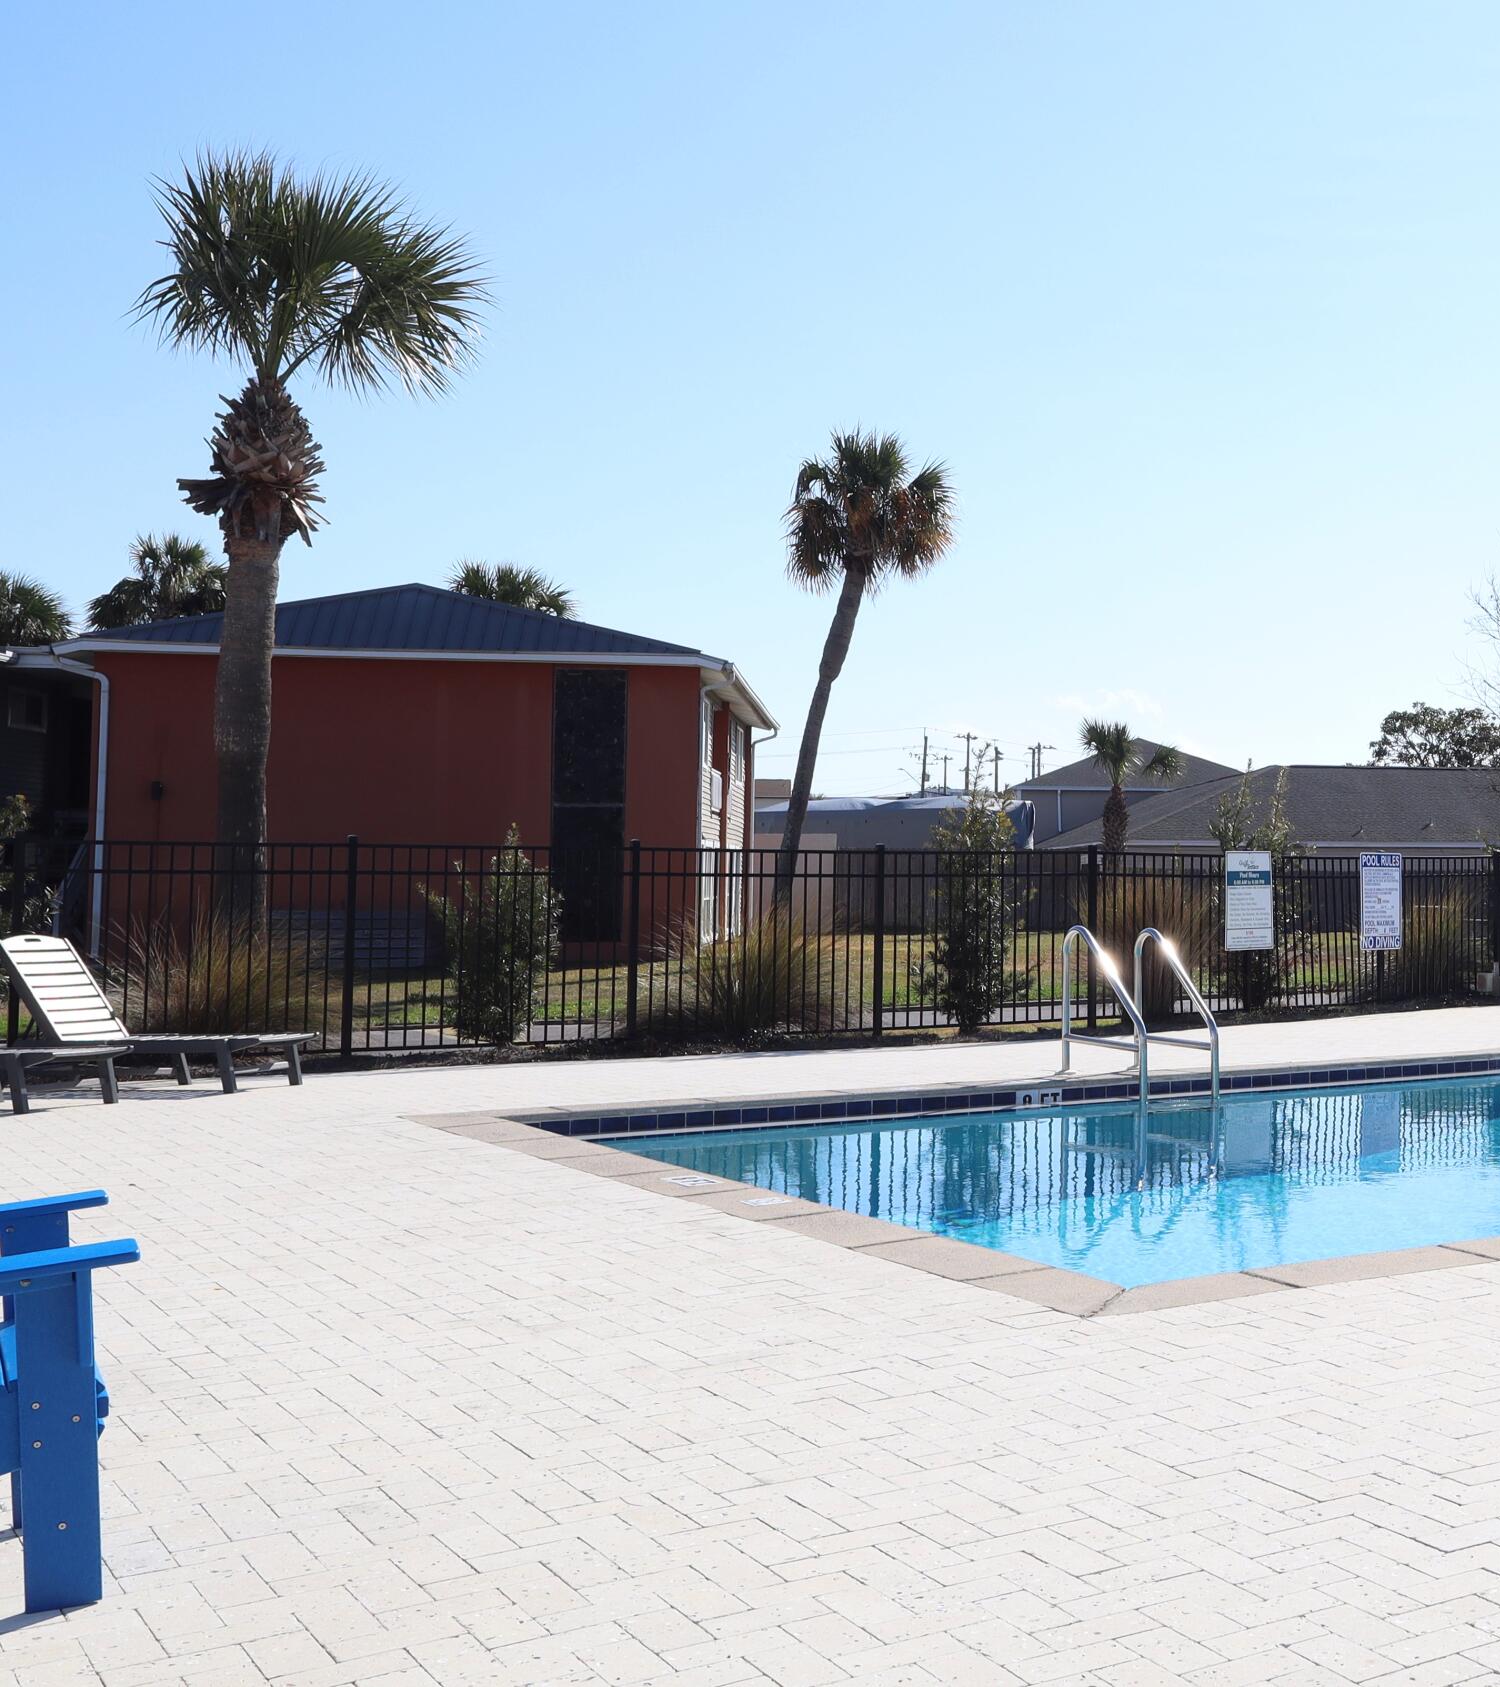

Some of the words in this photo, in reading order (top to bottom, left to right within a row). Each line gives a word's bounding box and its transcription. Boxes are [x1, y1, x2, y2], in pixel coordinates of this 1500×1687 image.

[1362, 855, 1380, 867] POOL
[1381, 855, 1400, 867] RULES
[1362, 936, 1374, 948] NO
[1375, 936, 1400, 948] DIVING
